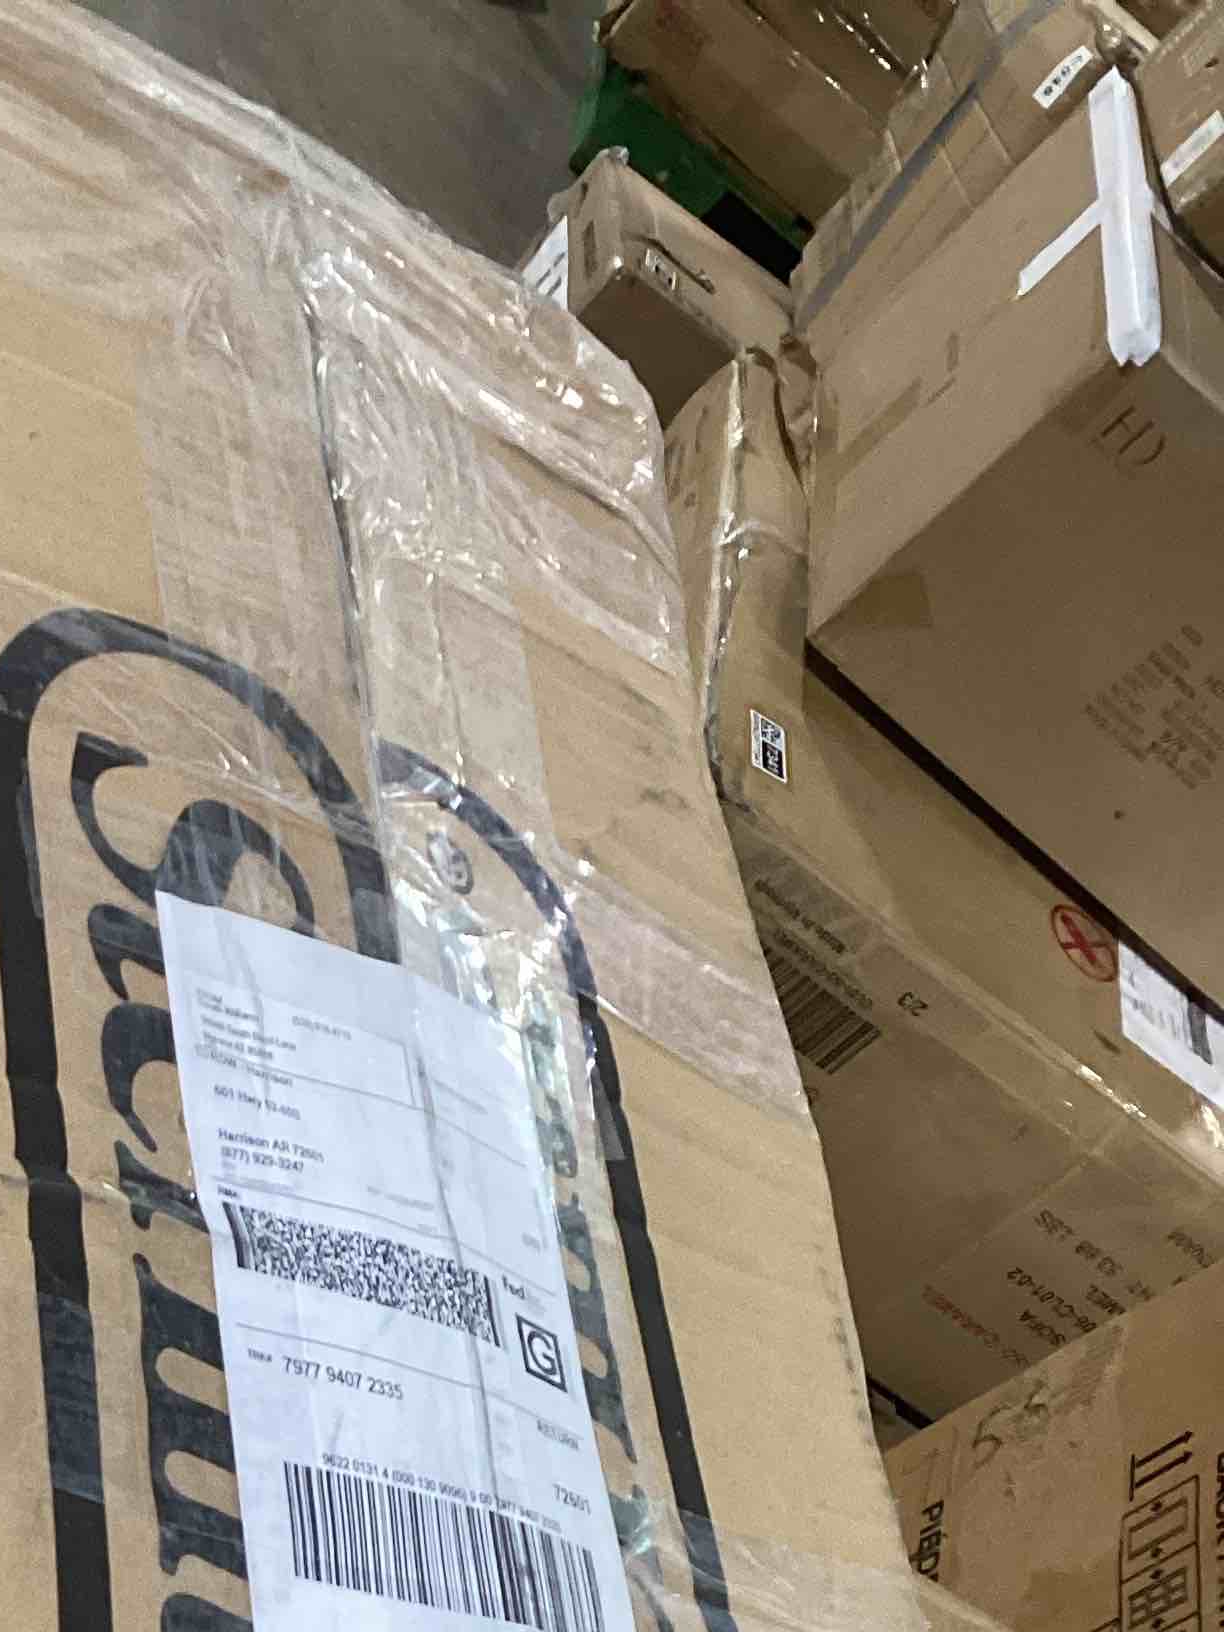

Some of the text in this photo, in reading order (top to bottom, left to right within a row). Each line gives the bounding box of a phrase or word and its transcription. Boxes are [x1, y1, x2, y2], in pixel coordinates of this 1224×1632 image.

[219, 1127, 269, 1150] Harrison
[273, 1138, 290, 1153] AR
[527, 1330, 557, 1376] G
[283, 1356, 321, 1379] 7977
[326, 1366, 362, 1389] 9407
[368, 1377, 404, 1400] 2335
[322, 1453, 349, 1471] 9622
[352, 1460, 378, 1477] 0131
[919, 1498, 945, 1583] PIED
